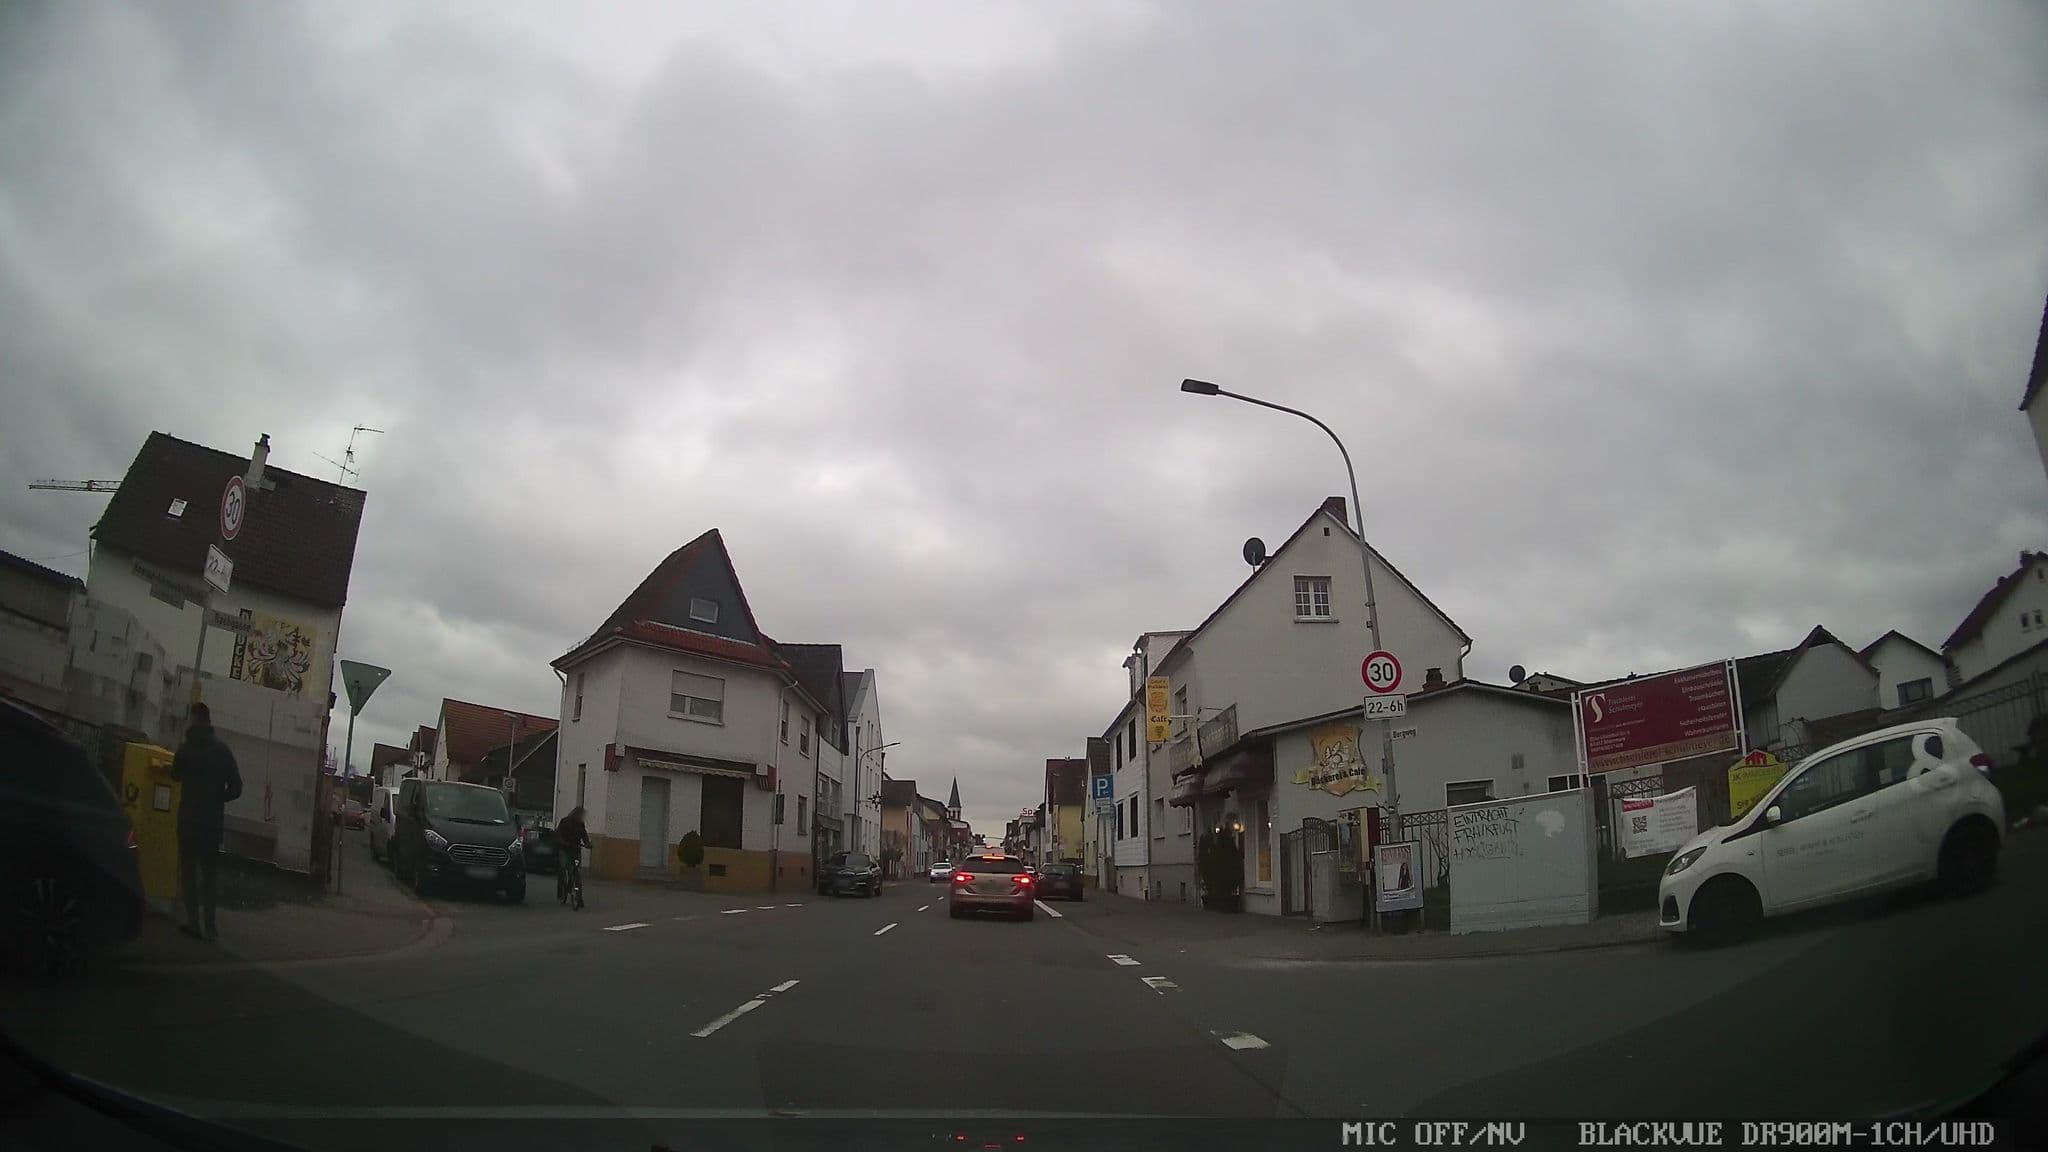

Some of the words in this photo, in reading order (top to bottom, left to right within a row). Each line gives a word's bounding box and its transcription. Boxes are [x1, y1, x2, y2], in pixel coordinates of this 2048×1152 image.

[226, 491, 241, 525] 30
[1370, 662, 1394, 682] 30
[1368, 700, 1404, 714] 22-6h
[1096, 778, 1109, 797] P
